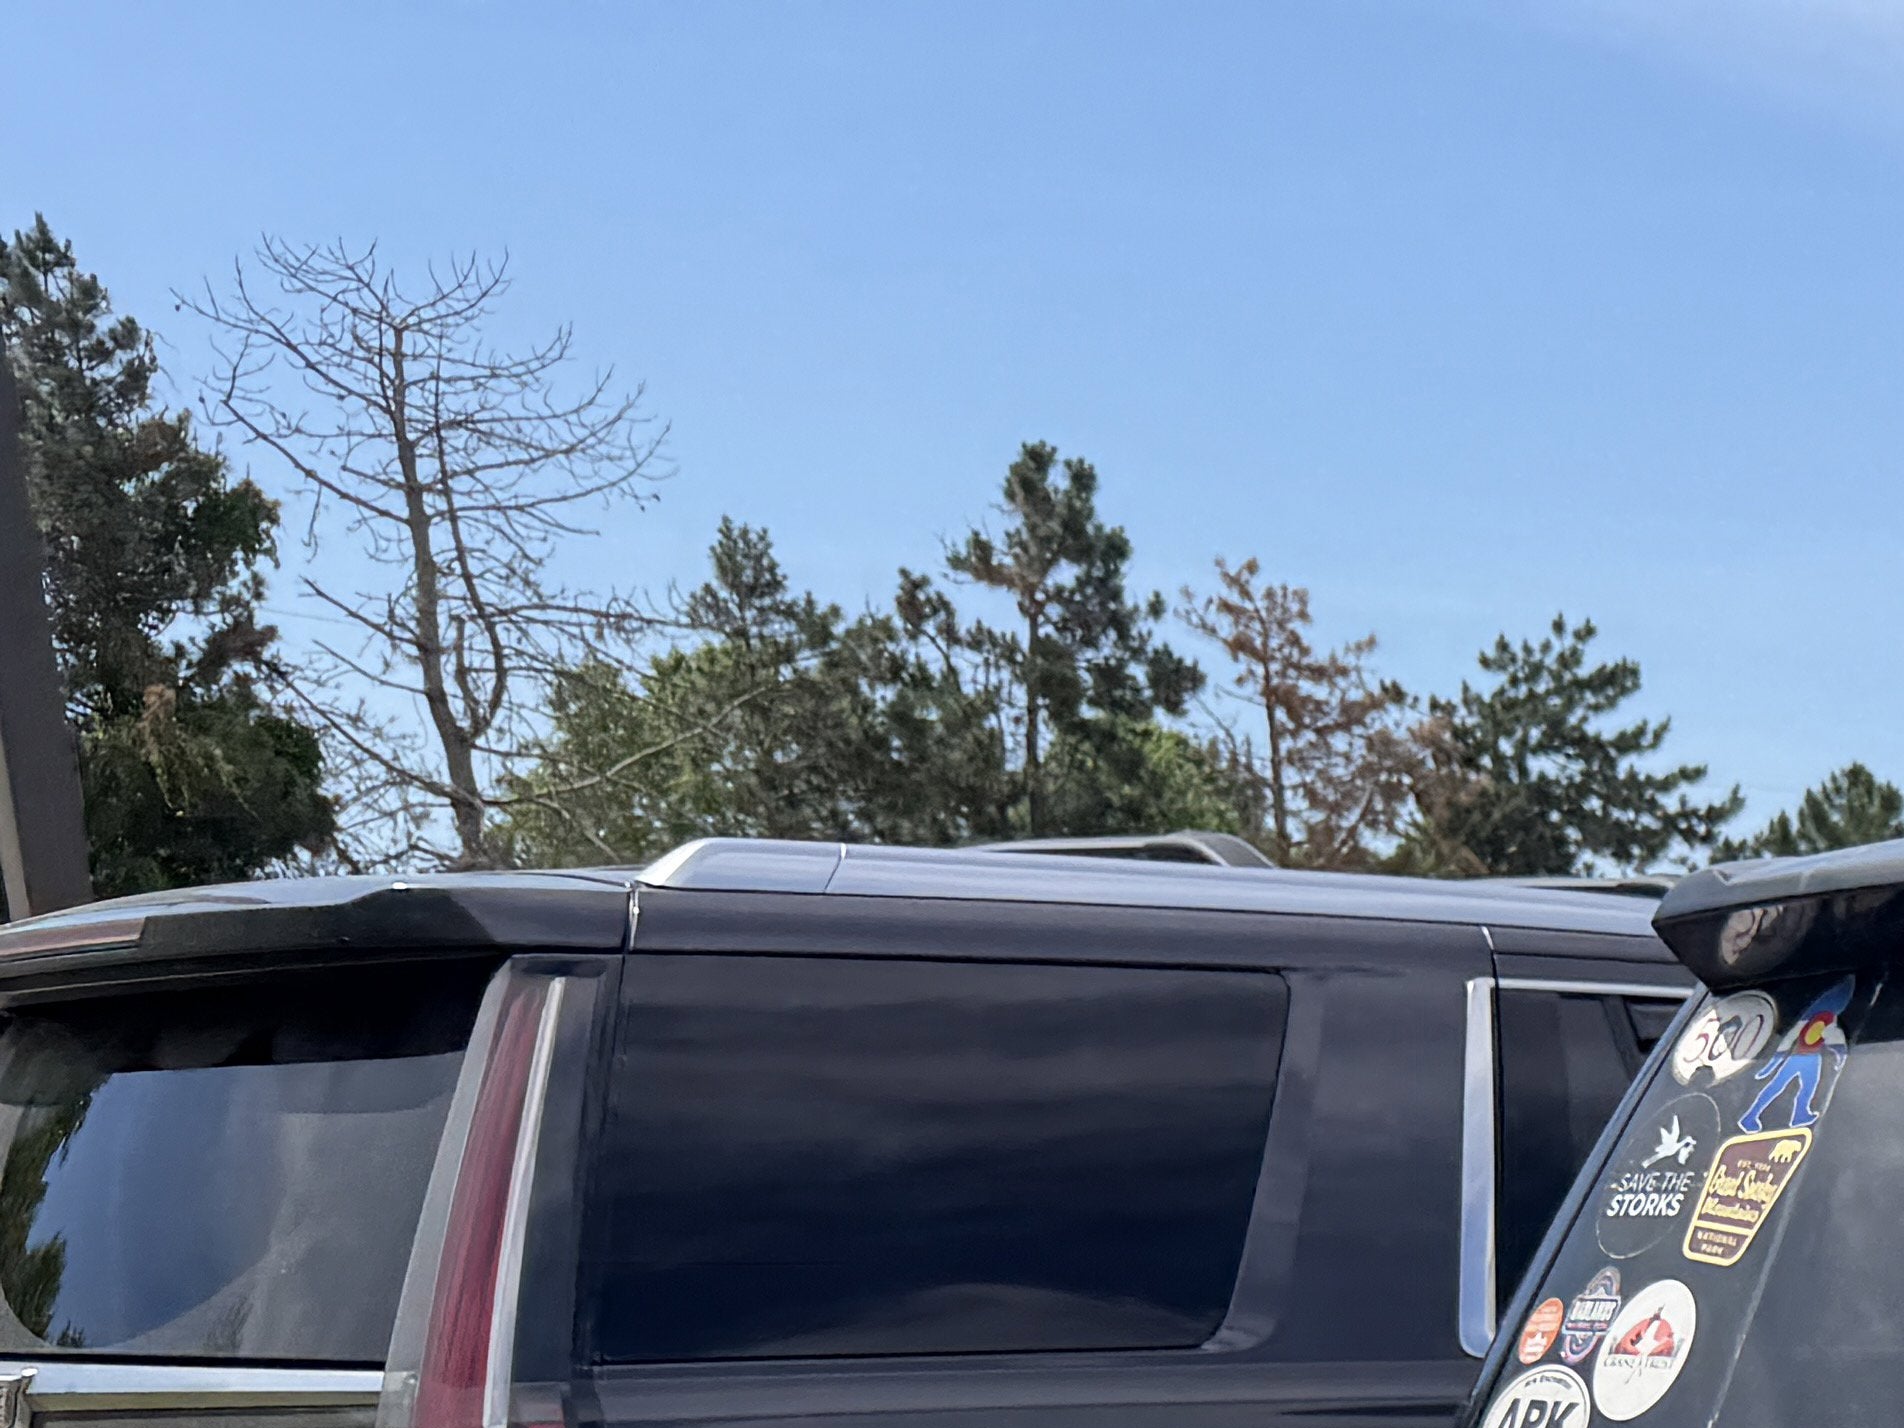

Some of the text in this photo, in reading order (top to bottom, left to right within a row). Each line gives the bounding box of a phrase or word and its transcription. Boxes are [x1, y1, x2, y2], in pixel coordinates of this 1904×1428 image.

[1618, 1171, 1695, 1191] SAVE THE
[1606, 1193, 1685, 1216] STORKS
